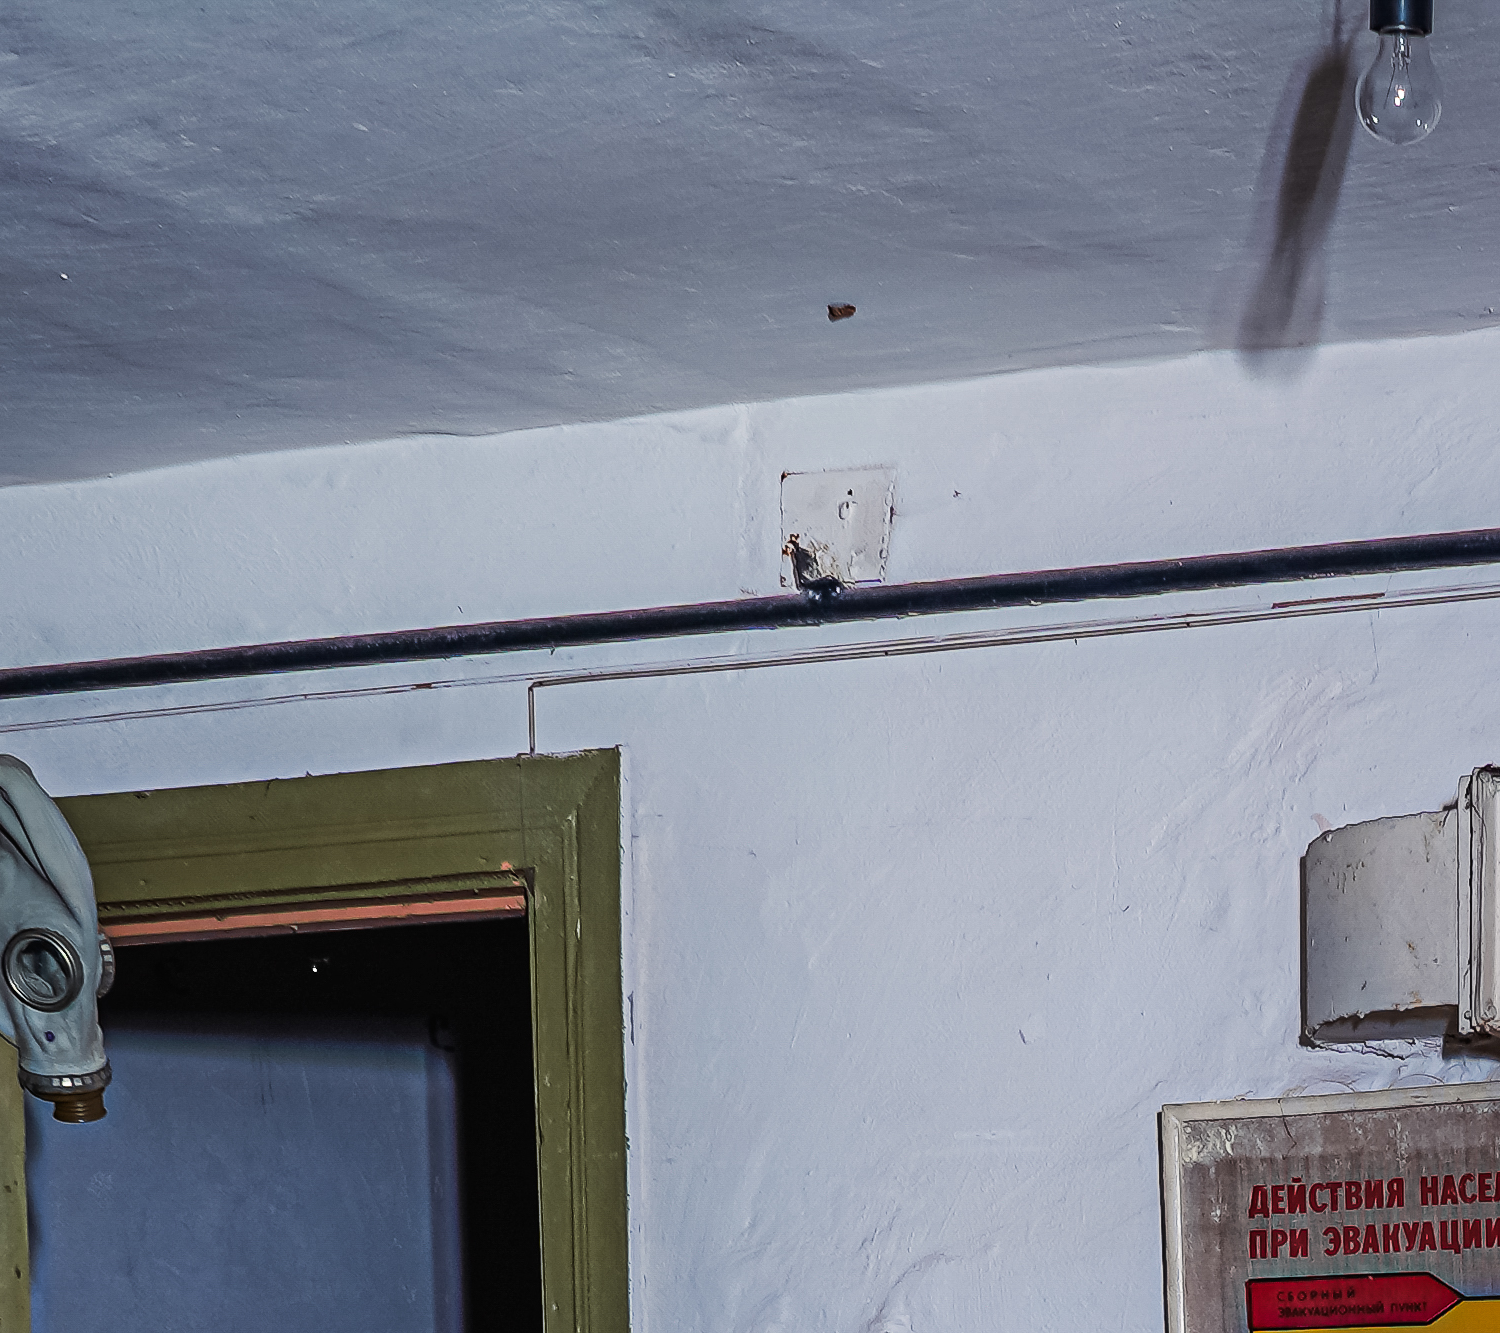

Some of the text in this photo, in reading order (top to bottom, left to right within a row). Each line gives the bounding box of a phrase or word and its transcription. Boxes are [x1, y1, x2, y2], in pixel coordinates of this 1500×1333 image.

[1249, 1177, 1405, 1219] ДЕЙСТВИЯ
[1249, 1228, 1309, 1259] ПРИ
[1277, 1286, 1356, 1301] СБОРНЫЙ
[1279, 1301, 1428, 1319] ЭВАКУАЦИОННЫЙ ПУНКТ
